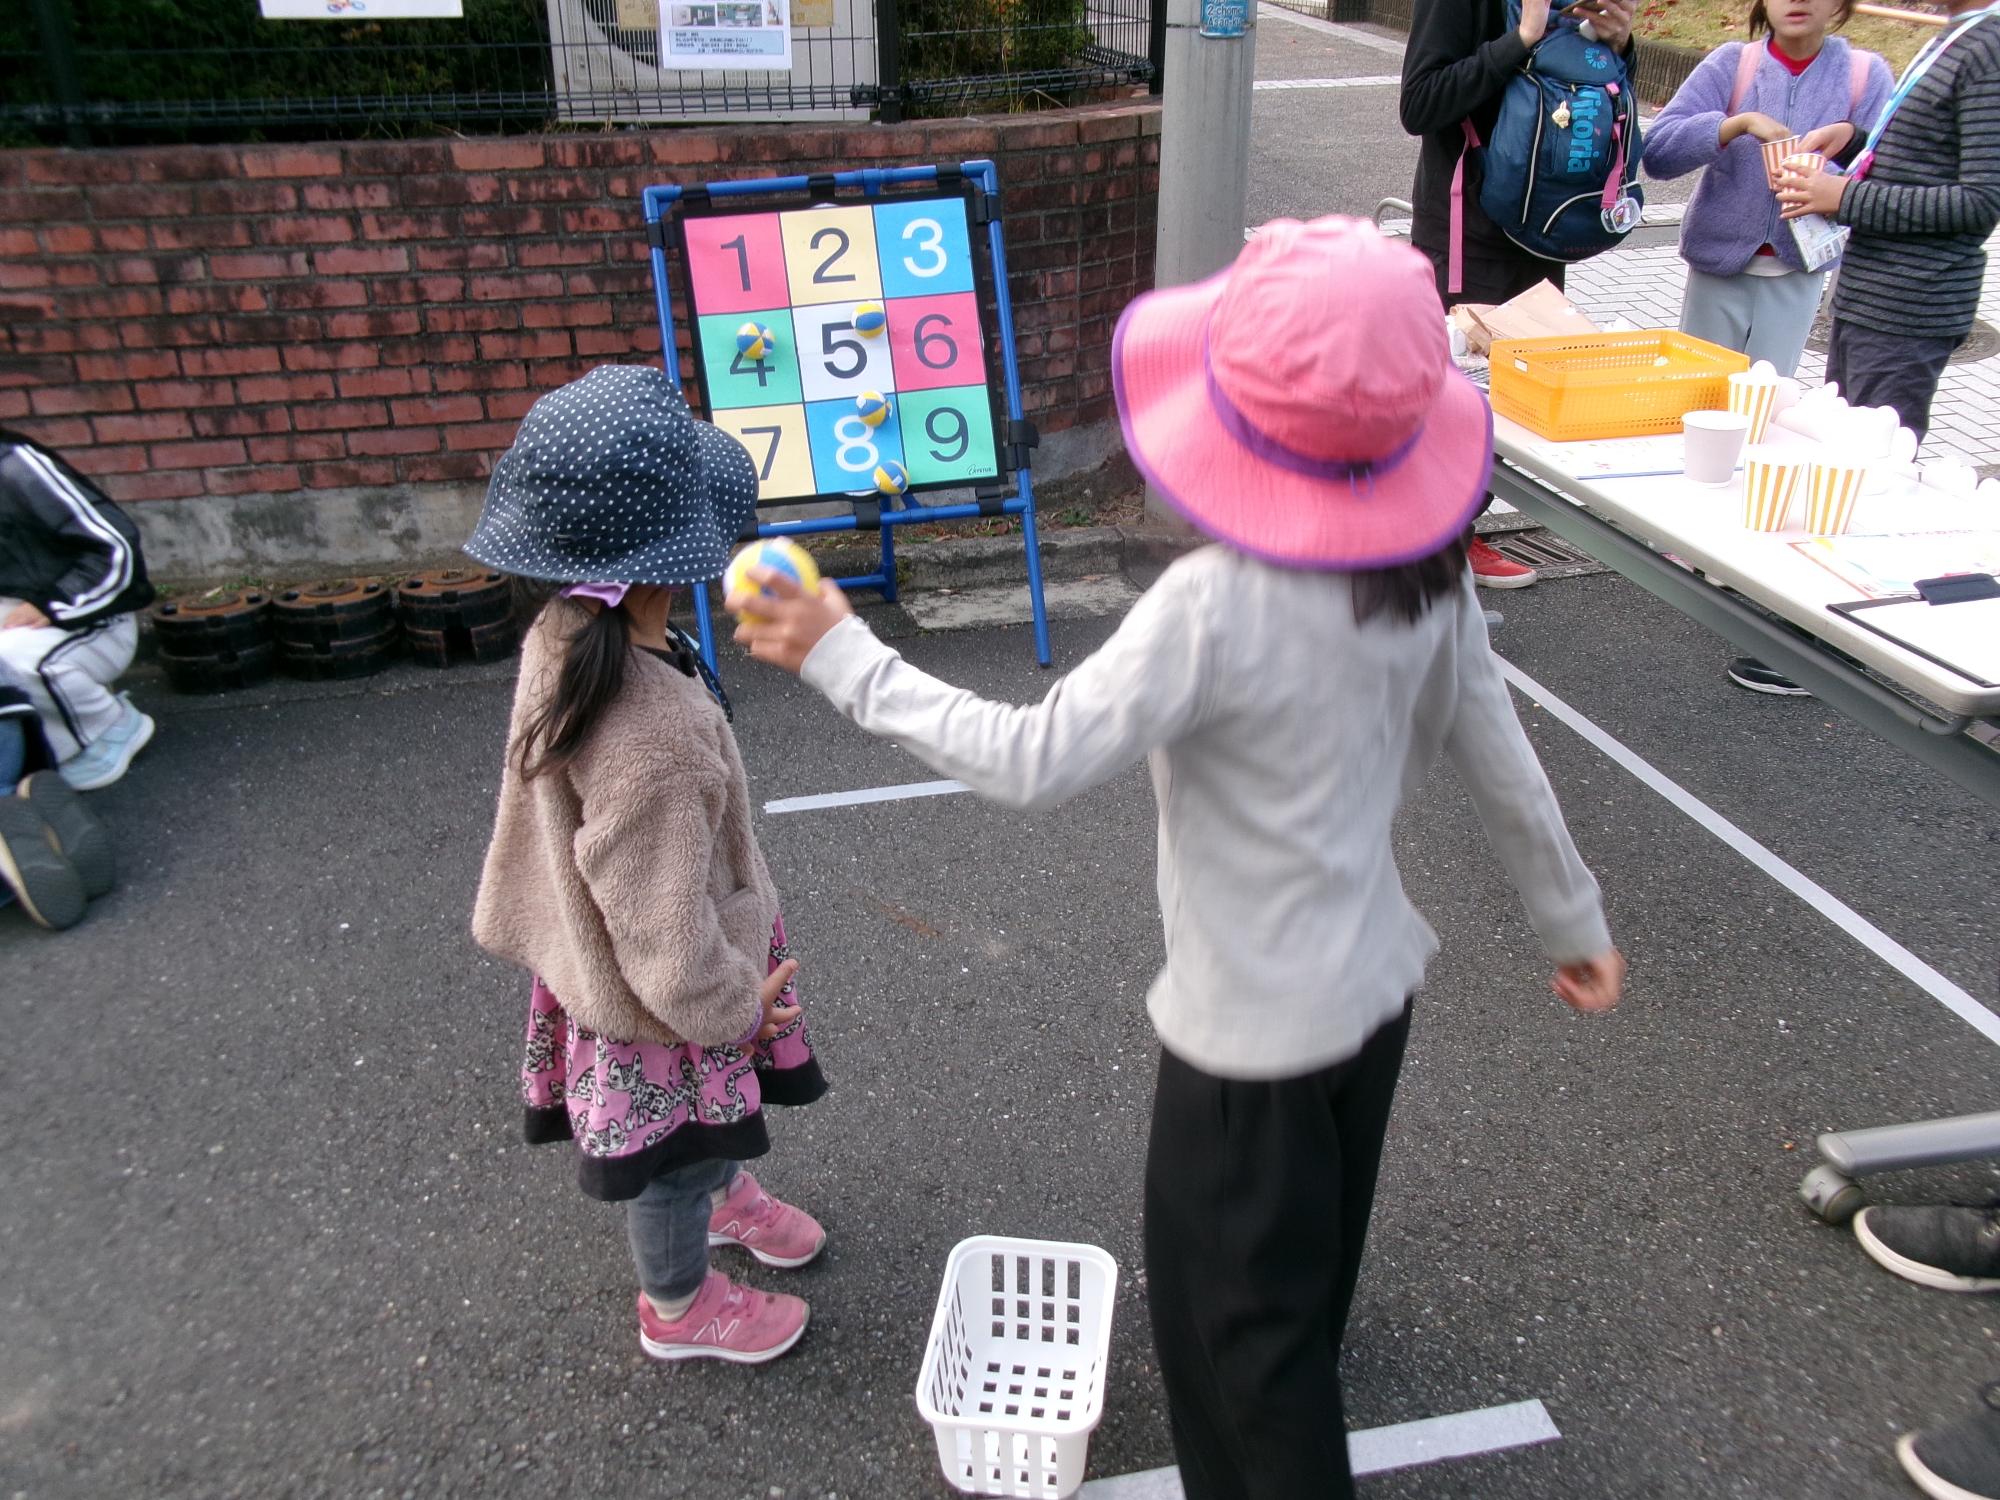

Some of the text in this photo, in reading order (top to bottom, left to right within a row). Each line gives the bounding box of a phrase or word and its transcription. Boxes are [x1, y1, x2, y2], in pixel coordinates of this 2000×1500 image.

[720, 218, 948, 292] 1 2 3
[821, 321, 868, 379] 5
[913, 314, 959, 369] 6
[740, 406, 969, 481] 7 8 9
